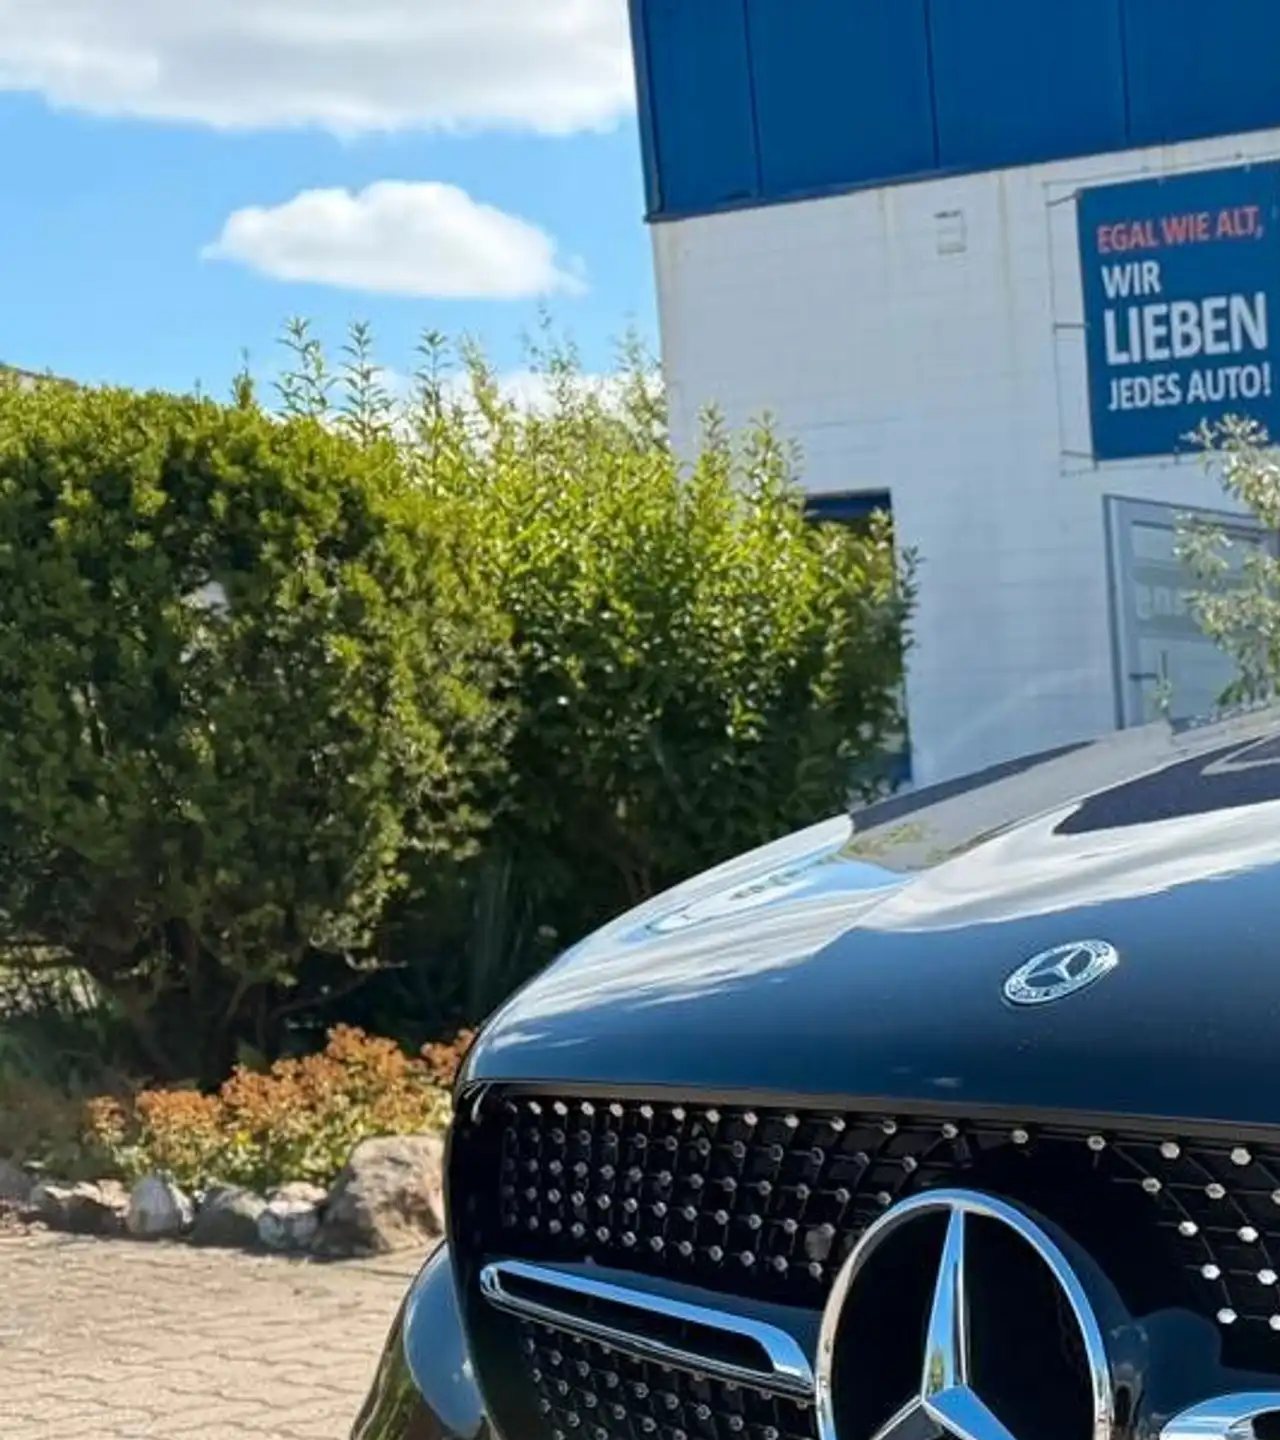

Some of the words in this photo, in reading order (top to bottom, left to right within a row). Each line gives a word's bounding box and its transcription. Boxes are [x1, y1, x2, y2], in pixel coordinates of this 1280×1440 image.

[1096, 218, 1158, 254] EGAL
[1161, 211, 1210, 245] WIE
[1216, 205, 1263, 240] ALT,
[1101, 259, 1162, 300] WIR
[1103, 291, 1269, 366] LIEBEN
[1107, 371, 1183, 411] JEDES
[1187, 361, 1272, 404] AUTO!
